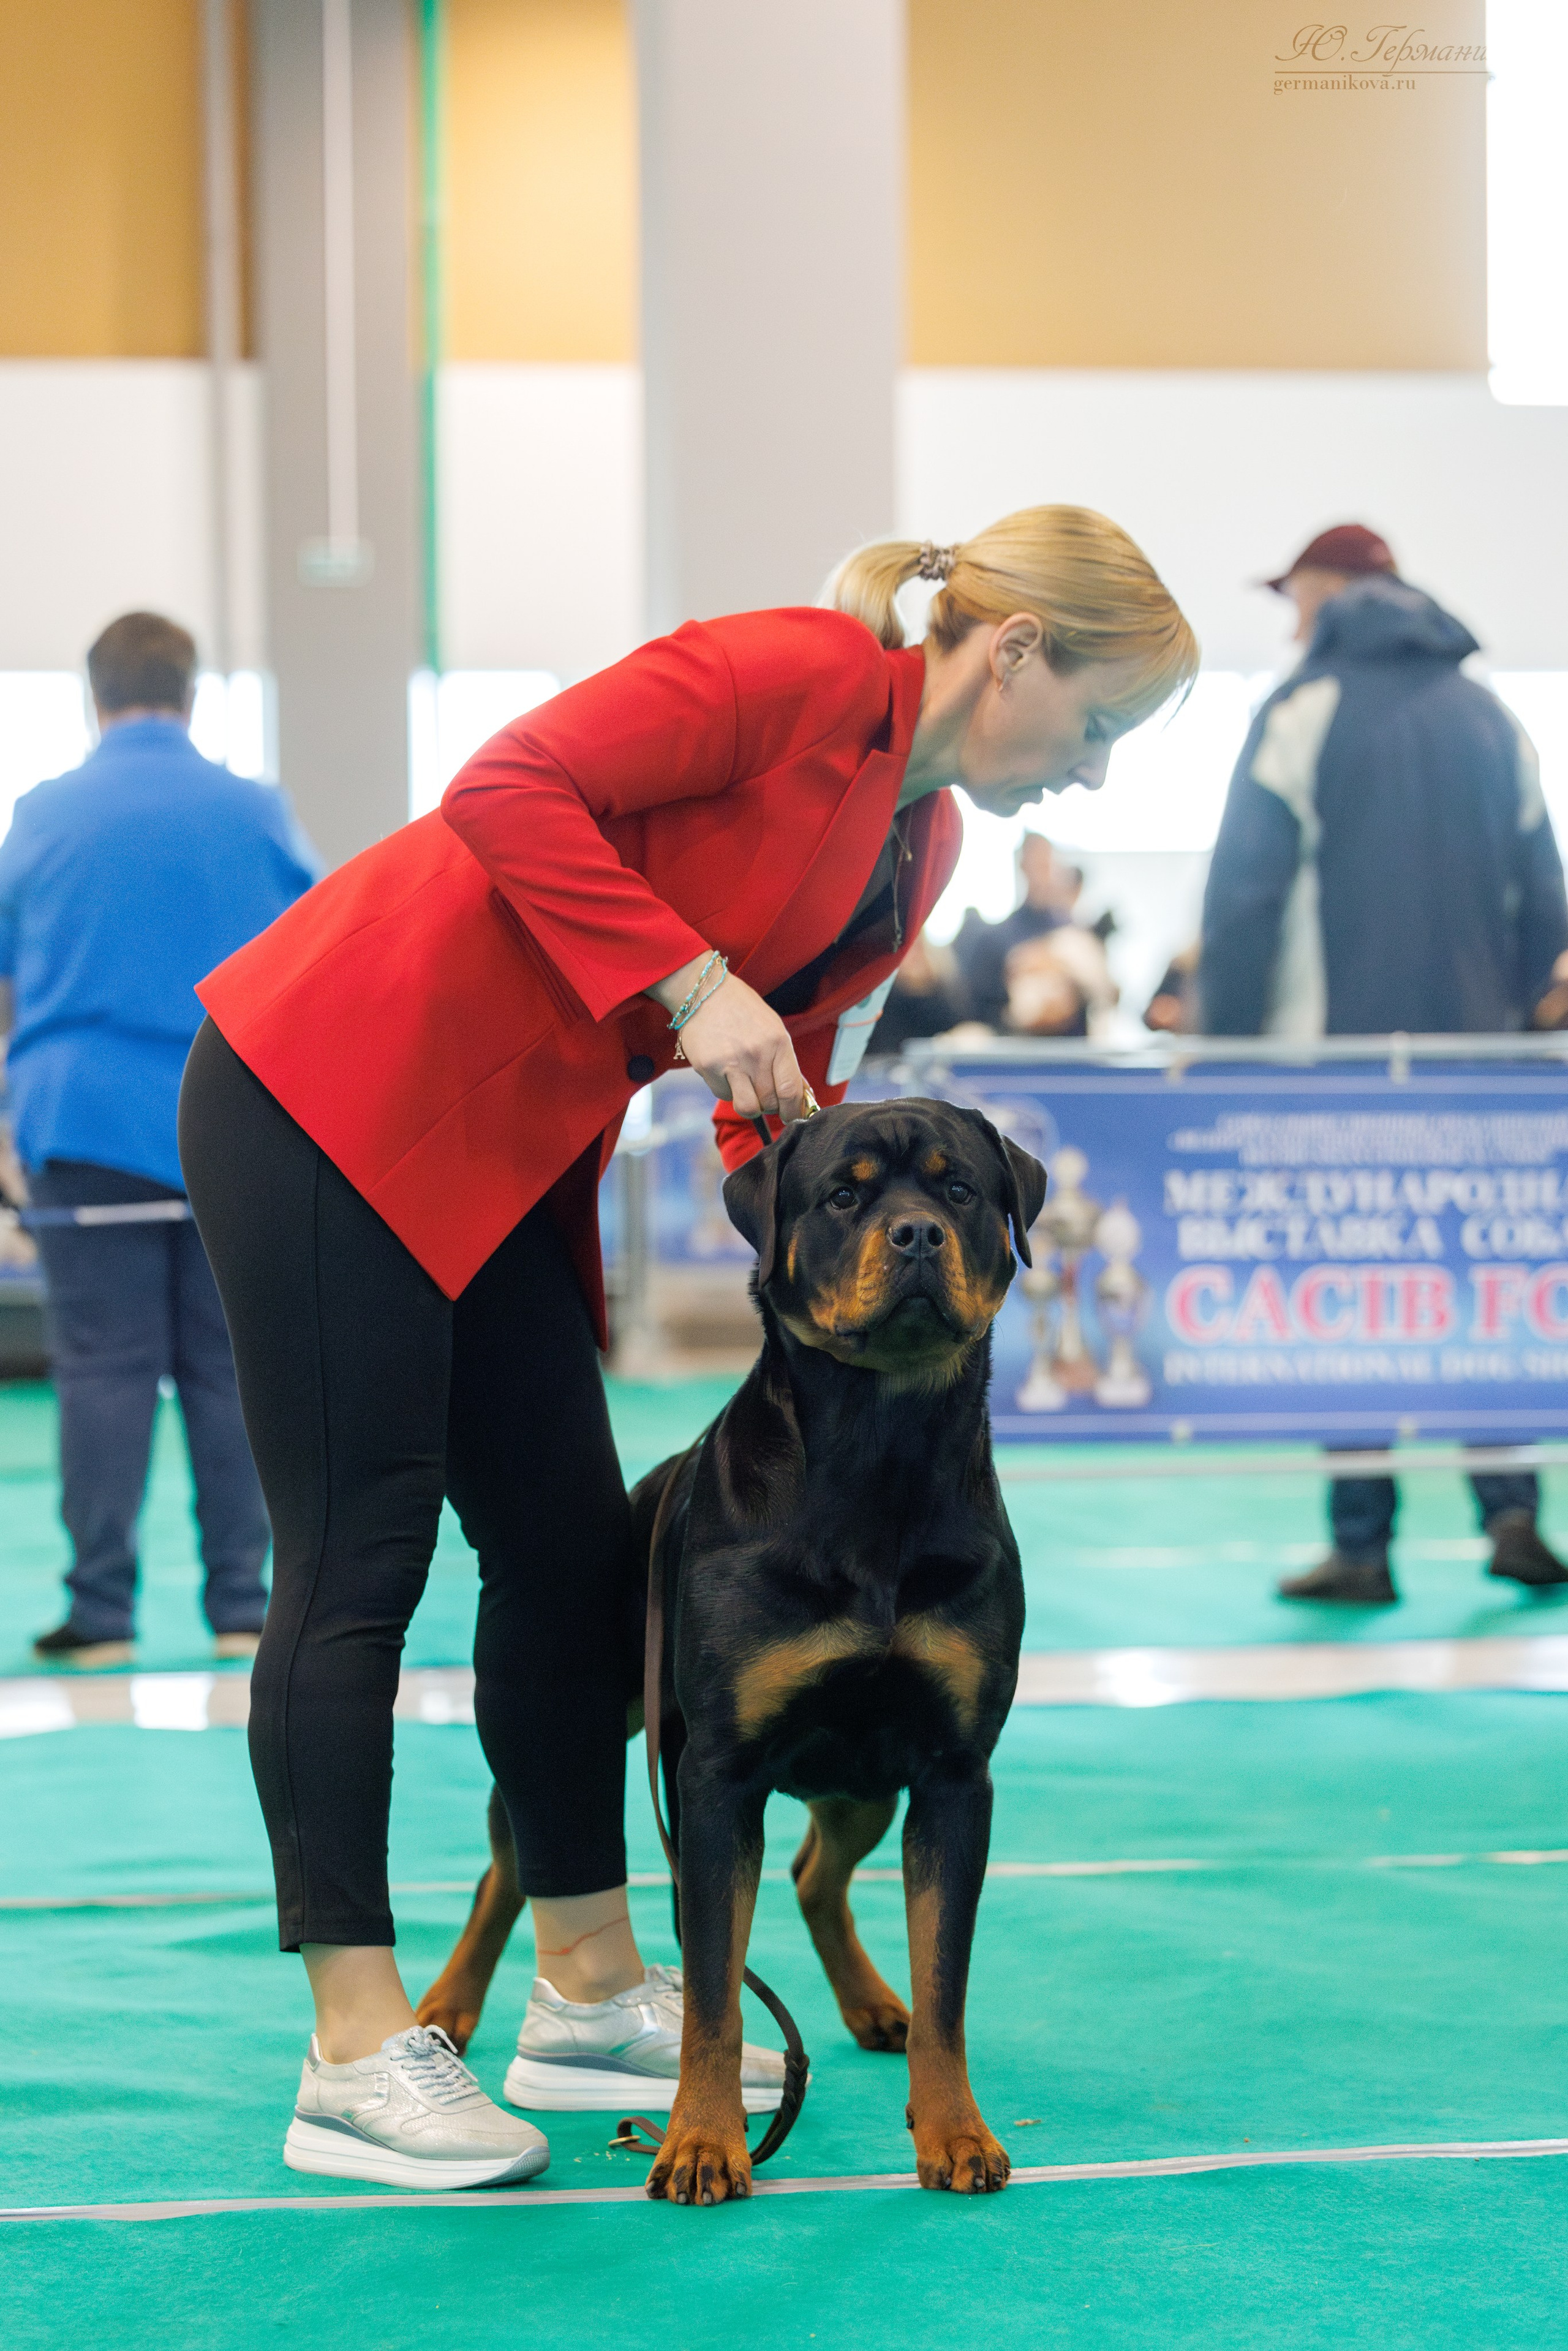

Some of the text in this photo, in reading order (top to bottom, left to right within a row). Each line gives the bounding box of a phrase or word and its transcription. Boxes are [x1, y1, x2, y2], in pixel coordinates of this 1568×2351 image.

[1165, 1169, 1568, 1215] МЕЖДУНАРОДН
[1460, 1215, 1568, 1259] СОБ
[1166, 1263, 1456, 1345] CACIB
